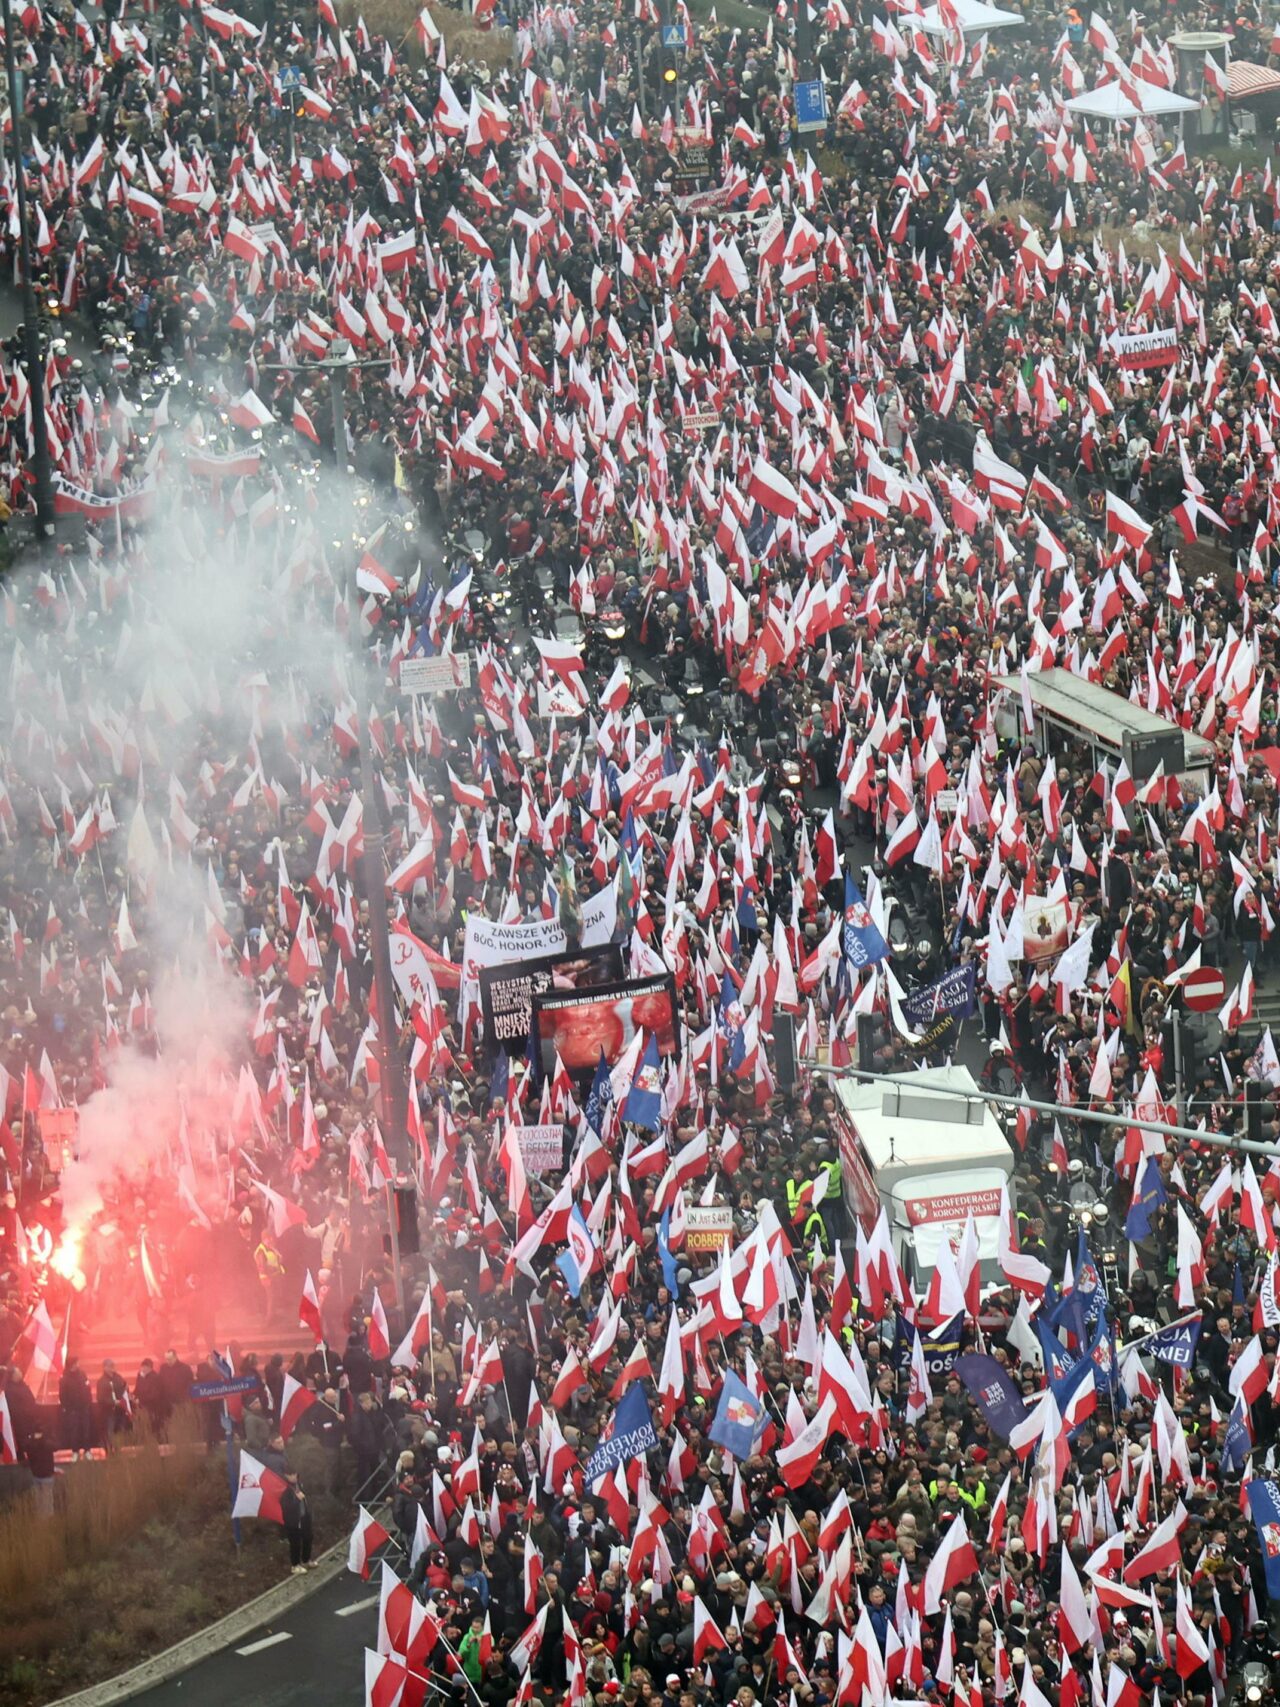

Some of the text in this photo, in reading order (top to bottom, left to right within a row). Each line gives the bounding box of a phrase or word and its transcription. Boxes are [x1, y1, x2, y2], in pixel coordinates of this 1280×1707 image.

[1121, 335, 1175, 354] KŁOBUCZYN
[491, 927, 539, 938] ZAWSZE
[473, 932, 497, 950] BÓG,
[499, 938, 547, 951] HONOR,
[489, 975, 532, 991] WSZYSTKO
[930, 1192, 999, 1209] KONFEDERACJA
[932, 1207, 964, 1218] KORONY
[687, 1232, 730, 1248] ROBBERY
